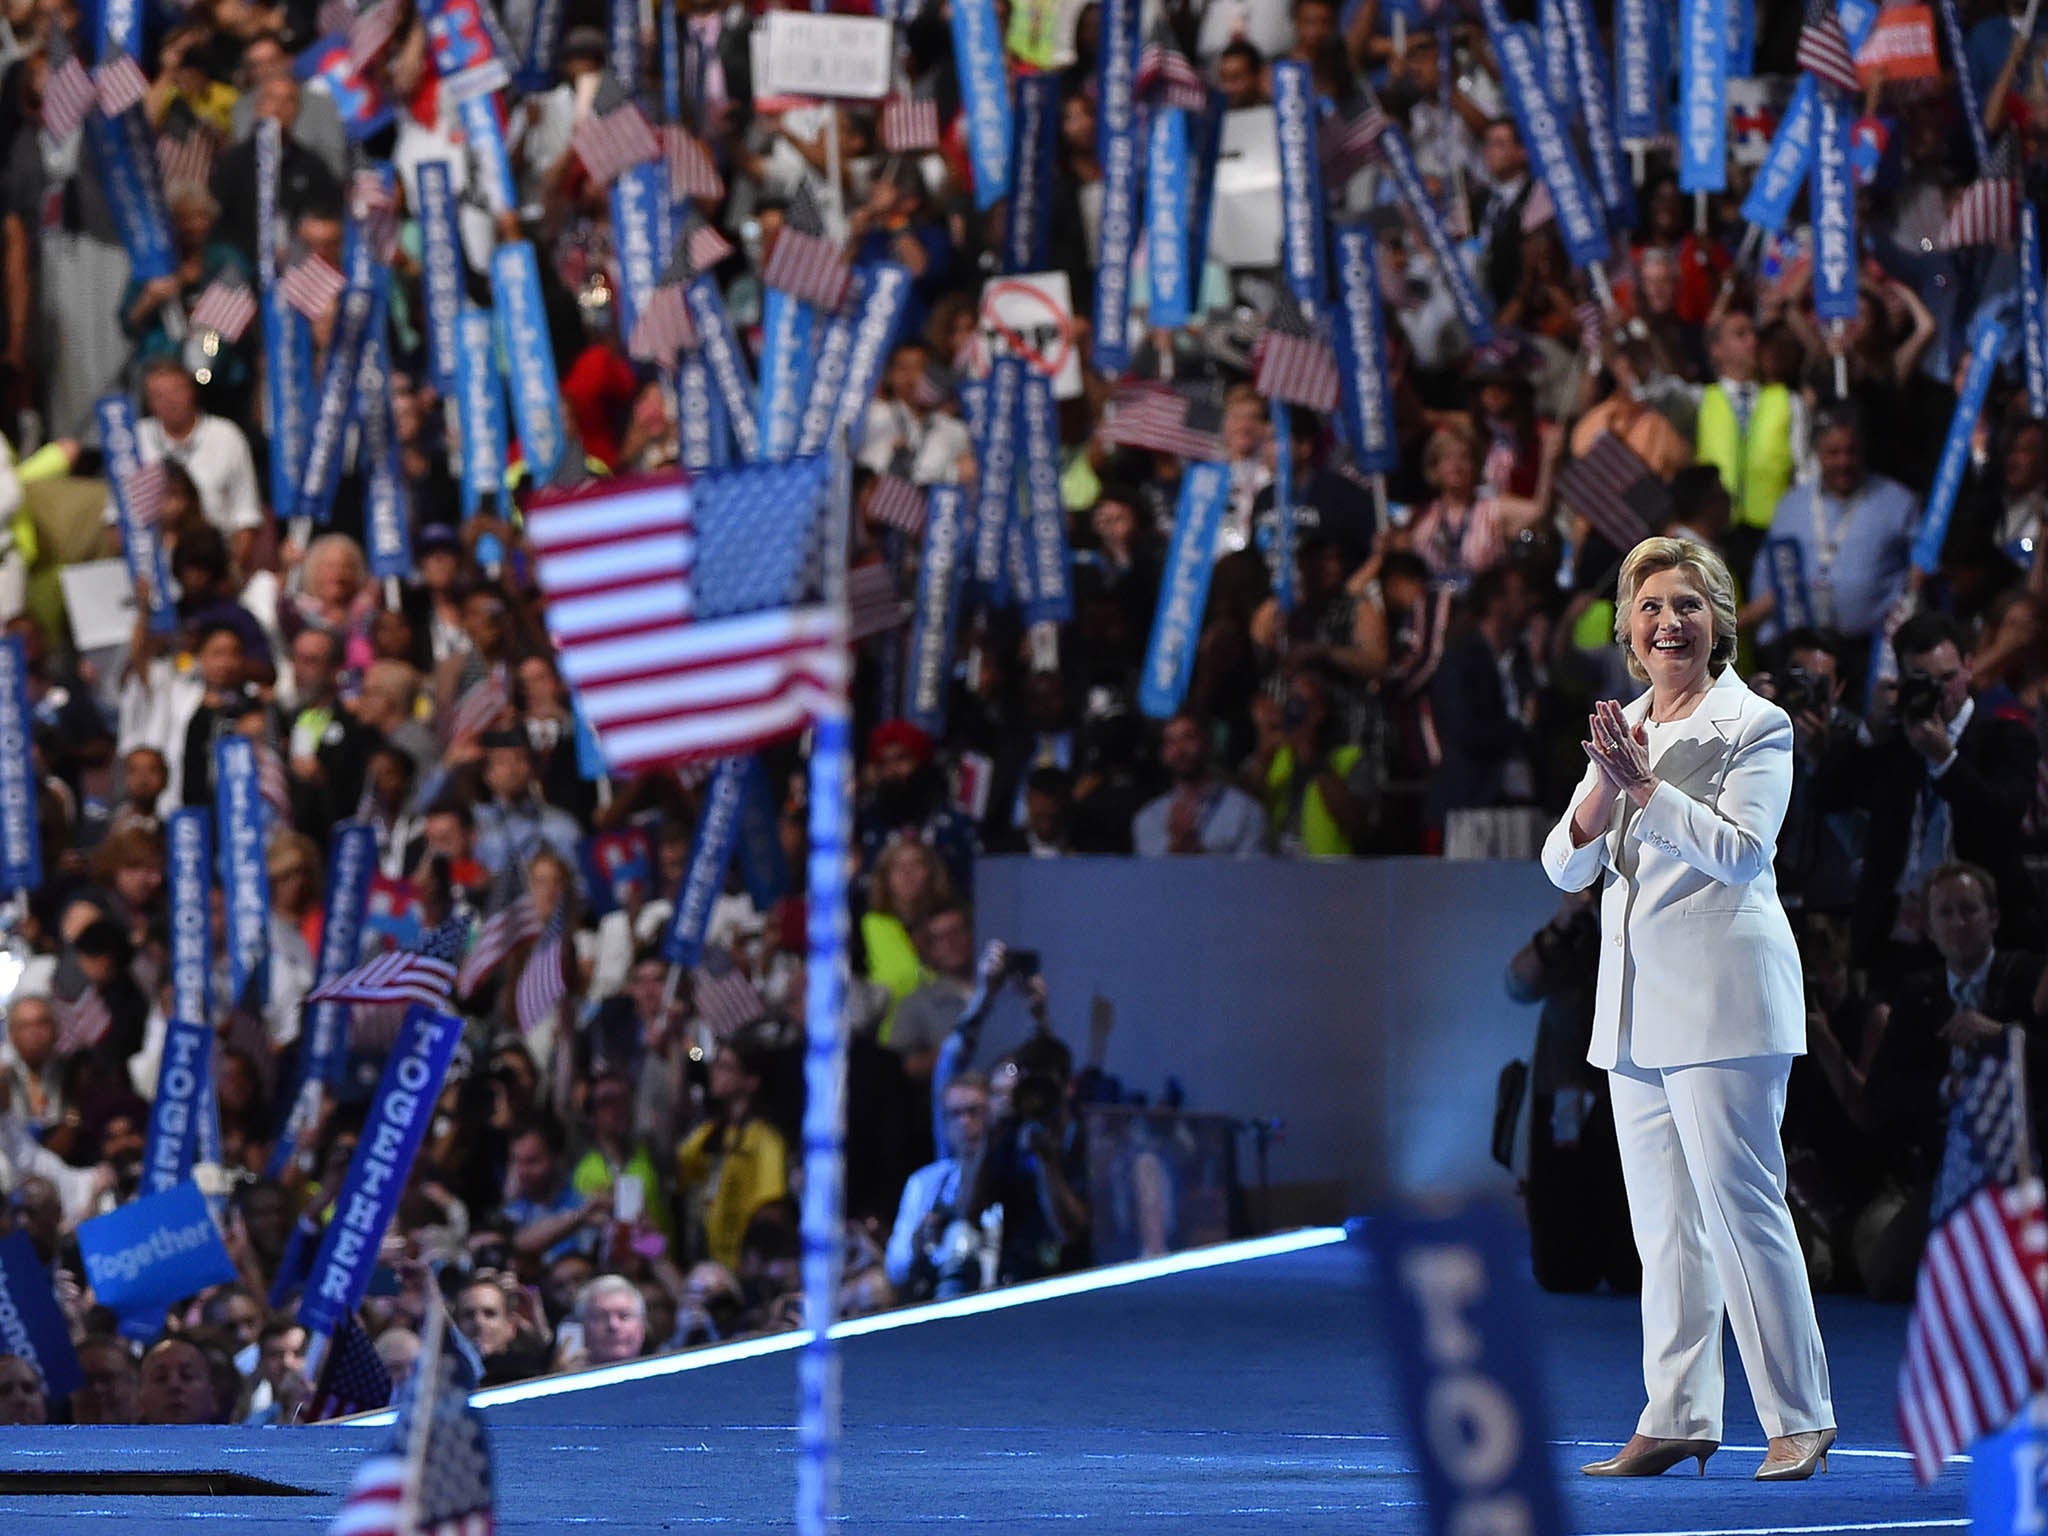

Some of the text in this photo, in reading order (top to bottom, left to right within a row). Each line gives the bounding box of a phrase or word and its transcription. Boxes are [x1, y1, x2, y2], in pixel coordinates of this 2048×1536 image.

[1152, 113, 1178, 299] ILLARY
[1820, 103, 1848, 293] ILLARY
[153, 1031, 199, 1191] TOGET
[320, 1020, 444, 1299] TOGETHER
[86, 1219, 209, 1281] Together
